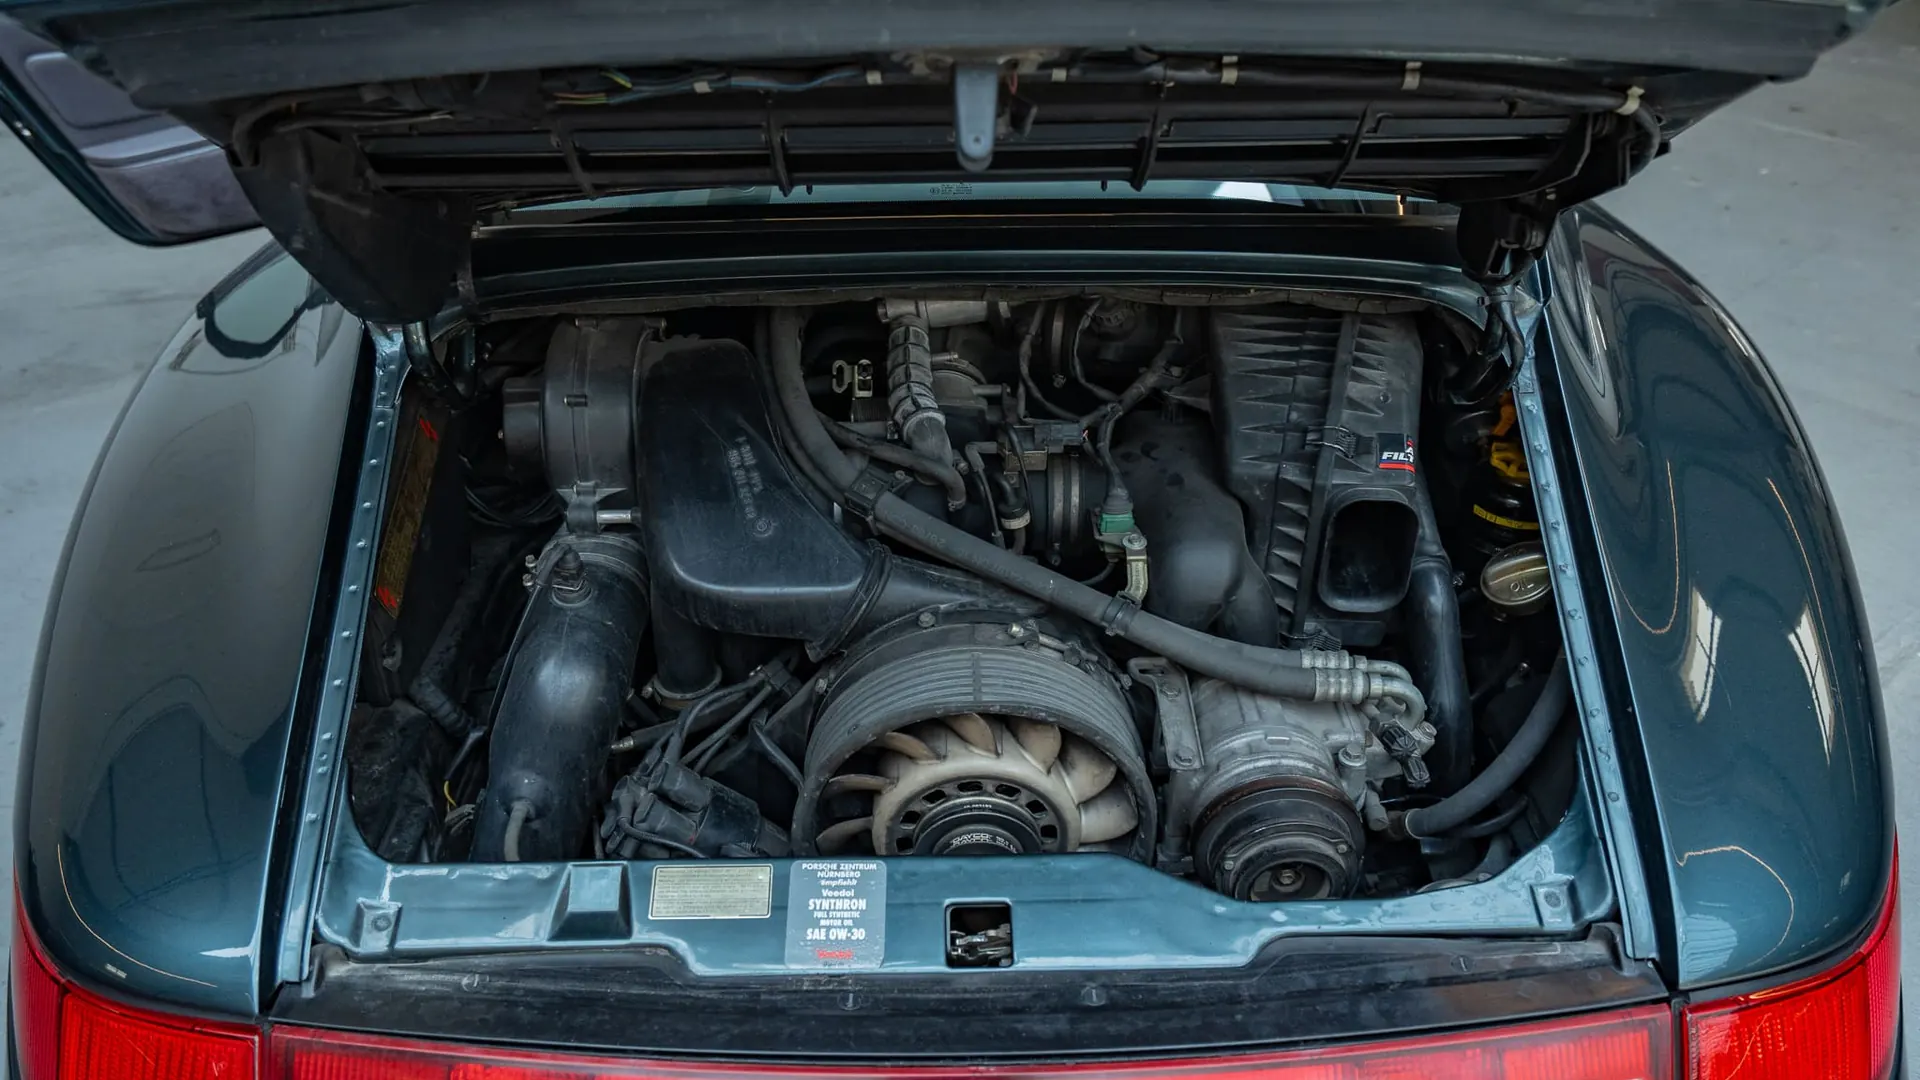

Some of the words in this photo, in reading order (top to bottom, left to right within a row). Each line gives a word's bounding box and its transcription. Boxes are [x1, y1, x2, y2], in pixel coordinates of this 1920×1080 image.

[817, 870, 861, 878] NÜRNBERG
[822, 889, 855, 897] Veedol
[808, 898, 867, 910] SYNTHRON
[806, 928, 827, 940] SAE
[829, 928, 866, 940] 0W-30
